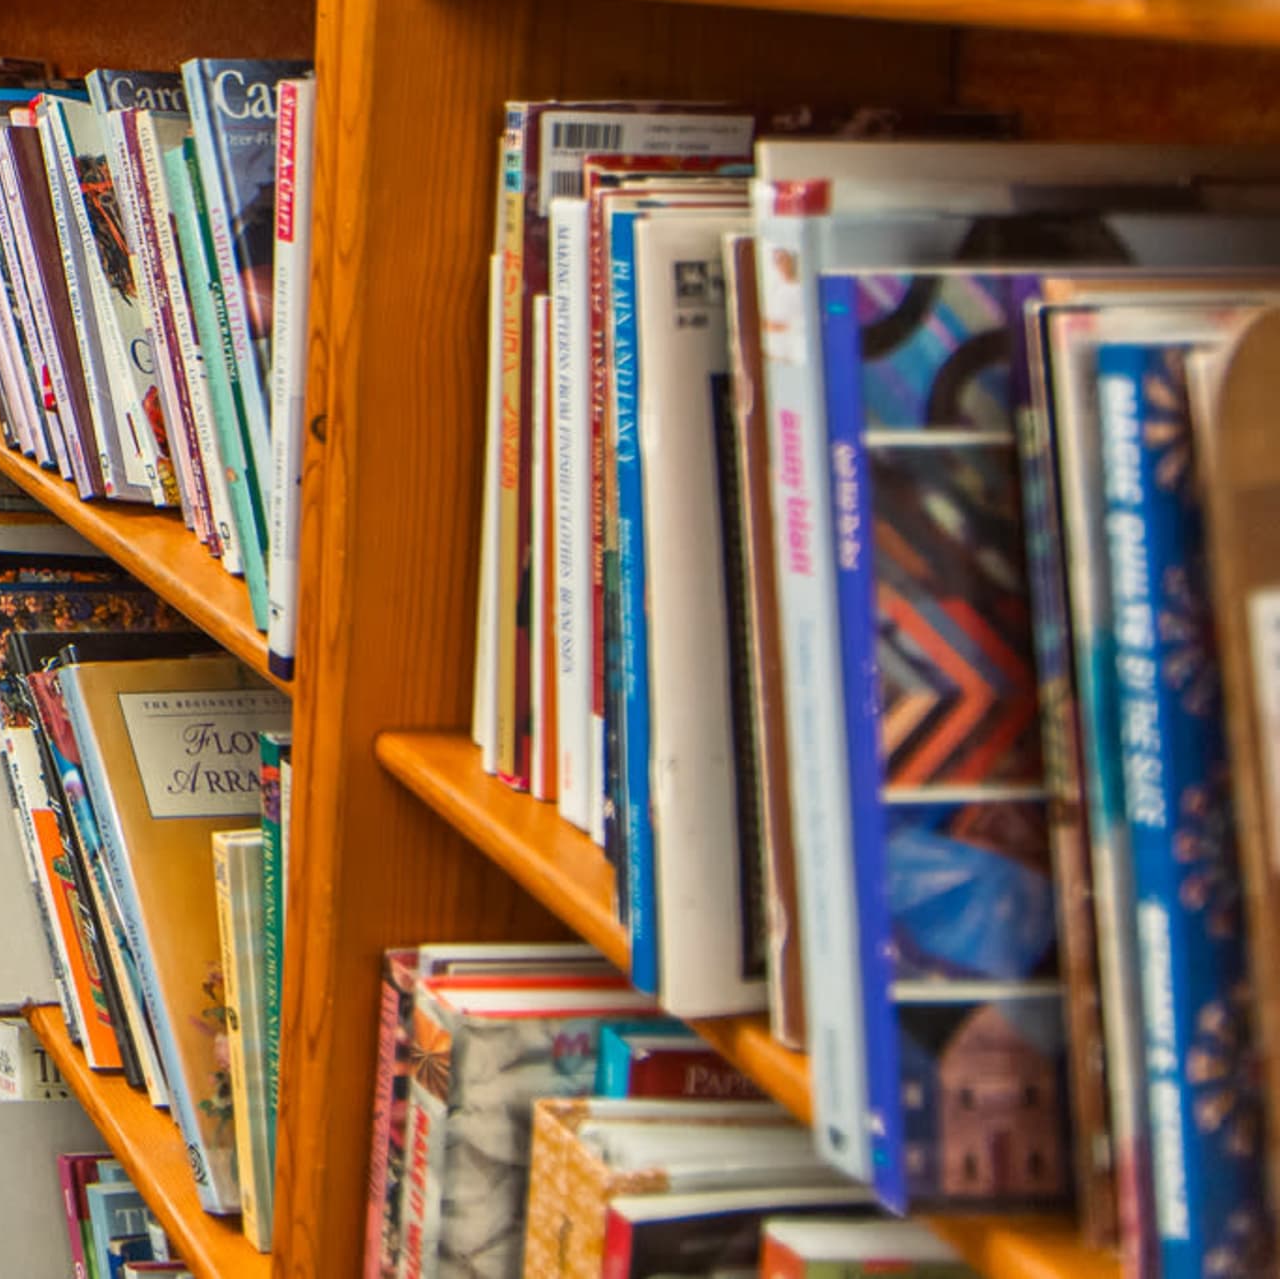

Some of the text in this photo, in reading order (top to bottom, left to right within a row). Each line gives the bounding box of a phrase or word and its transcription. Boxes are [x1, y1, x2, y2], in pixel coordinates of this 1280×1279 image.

[276, 81, 298, 242] START-A-CRAFT
[140, 125, 214, 454] GREETING CARDS FOR EVERY OCCASION
[211, 207, 247, 362] CARDCRAFTING
[213, 280, 239, 384] CARDCRAFTING
[613, 258, 637, 464] PLAIN AND FANCY
[778, 408, 814, 577] anny blatt
[1097, 371, 1167, 829] MAGIC QUILTS BY THE SLICE
[261, 827, 280, 1113] ARRANGING FLOWERS NATURALLY
[411, 1106, 430, 1218] MAKE IT
